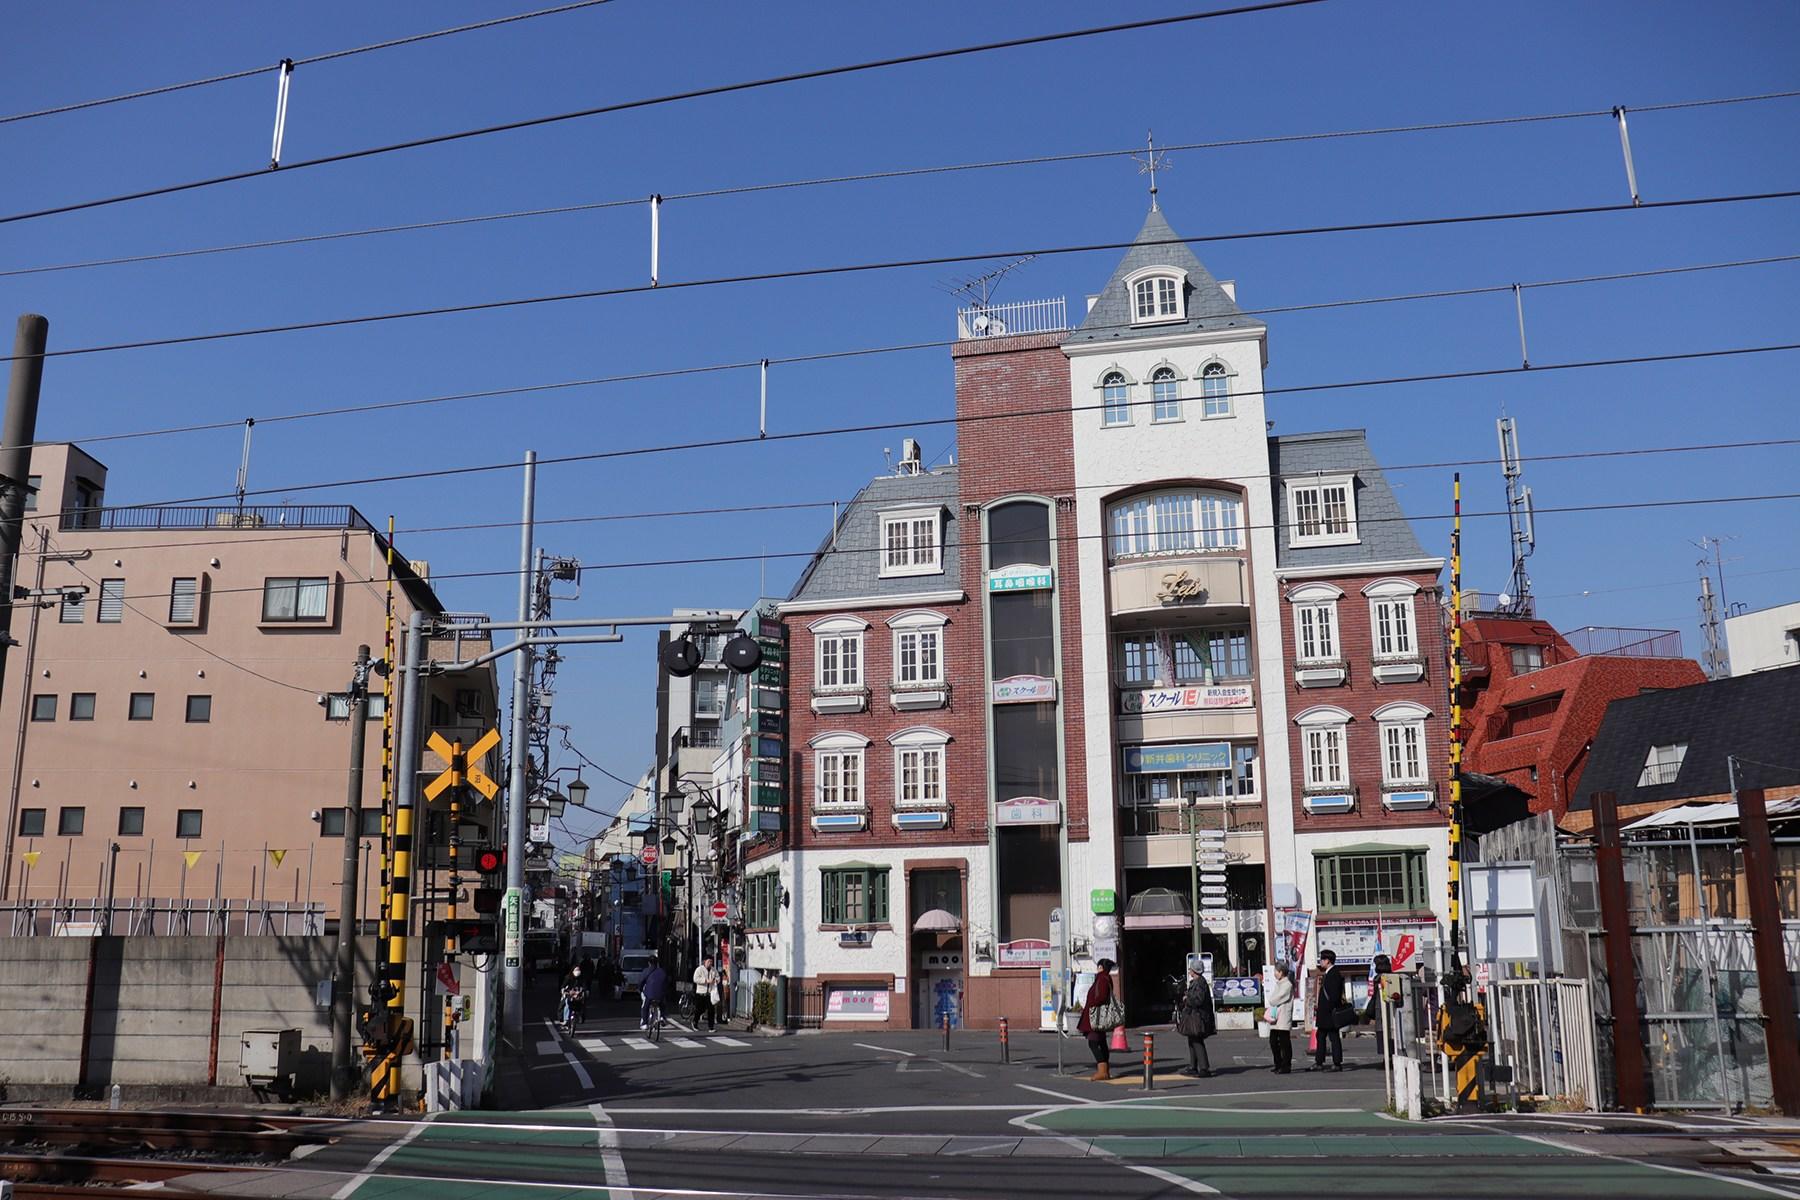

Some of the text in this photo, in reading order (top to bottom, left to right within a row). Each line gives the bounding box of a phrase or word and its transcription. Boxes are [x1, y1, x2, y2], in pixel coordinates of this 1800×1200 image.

[994, 576, 1046, 589] 耳鼻咽喉科
[1012, 686, 1037, 695] スクール
[1146, 691, 1182, 707] スクール
[1143, 751, 1226, 764] 新井歯科クリニック
[1011, 807, 1042, 819] 歯科
[928, 955, 963, 964] moo
[842, 996, 874, 1004] moon
